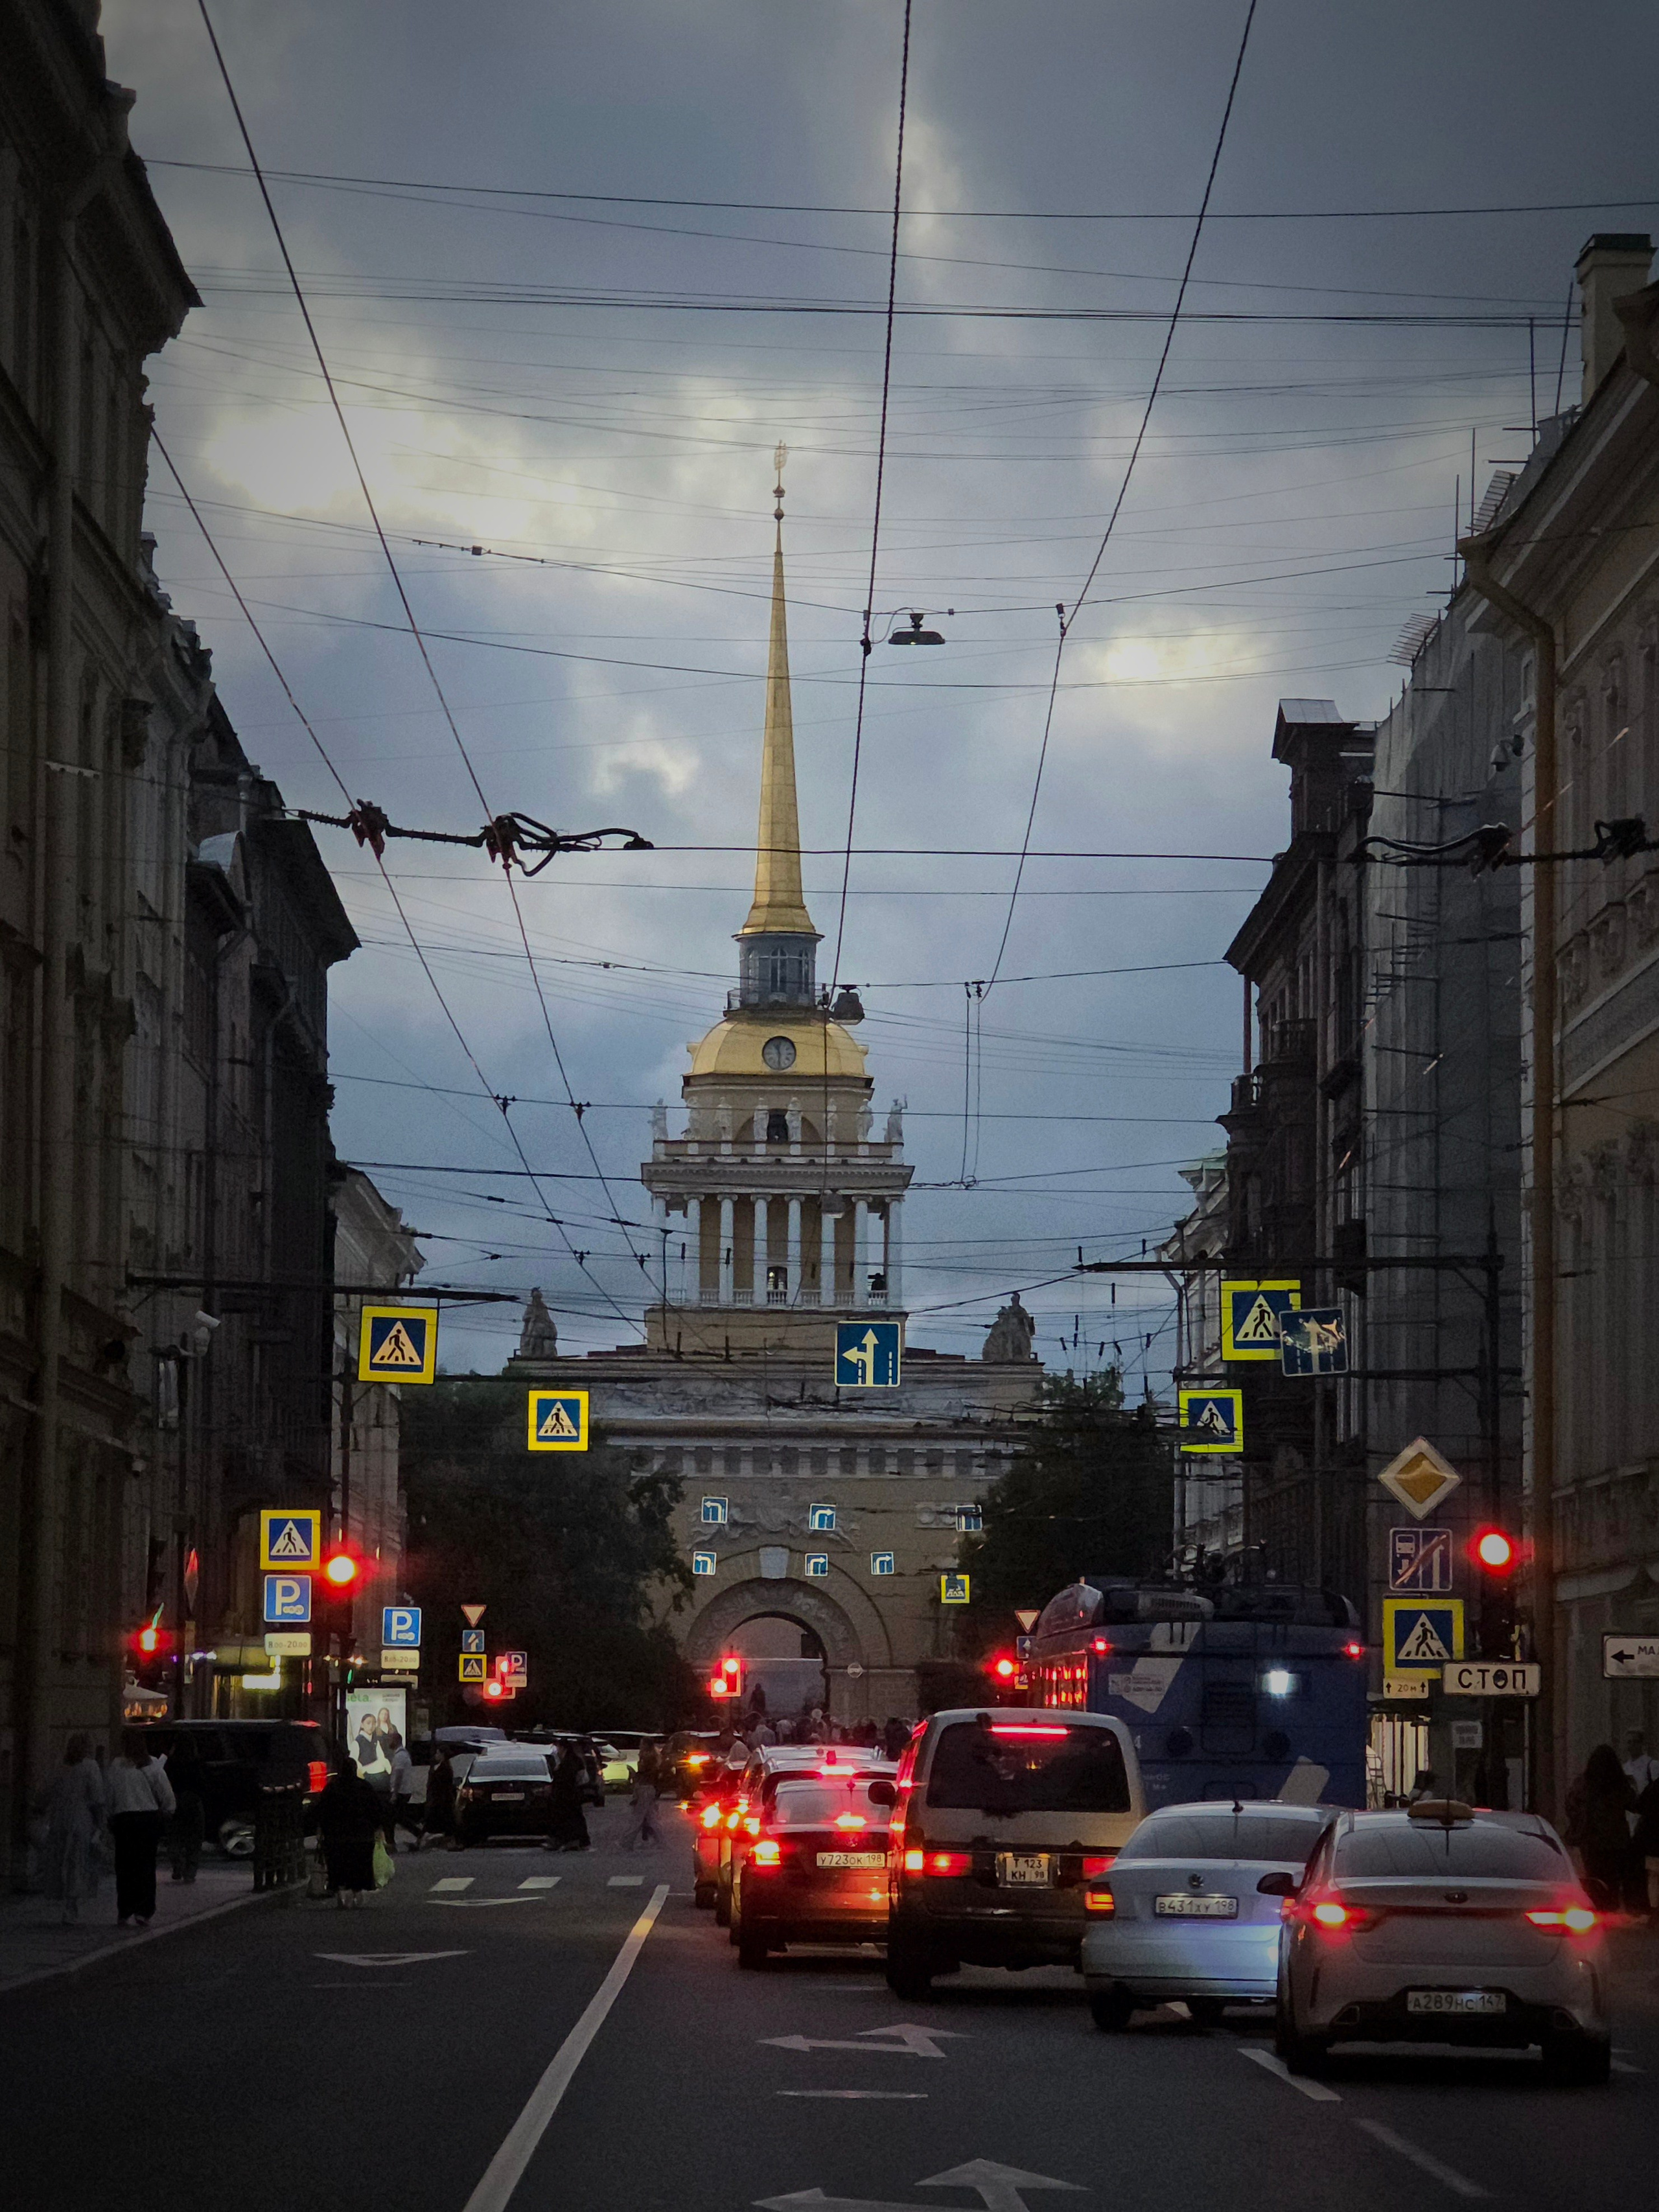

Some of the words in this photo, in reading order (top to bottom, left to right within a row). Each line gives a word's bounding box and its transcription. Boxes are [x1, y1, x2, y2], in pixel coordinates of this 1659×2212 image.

[275, 1580, 301, 1616] P
[391, 1611, 413, 1641] P
[1638, 1646, 1659, 1655] МА
[1457, 1668, 1526, 1689] СТОП
[1397, 1684, 1409, 1692] 20
[1024, 1859, 1042, 1869] 123
[1012, 1871, 1026, 1880] КН
